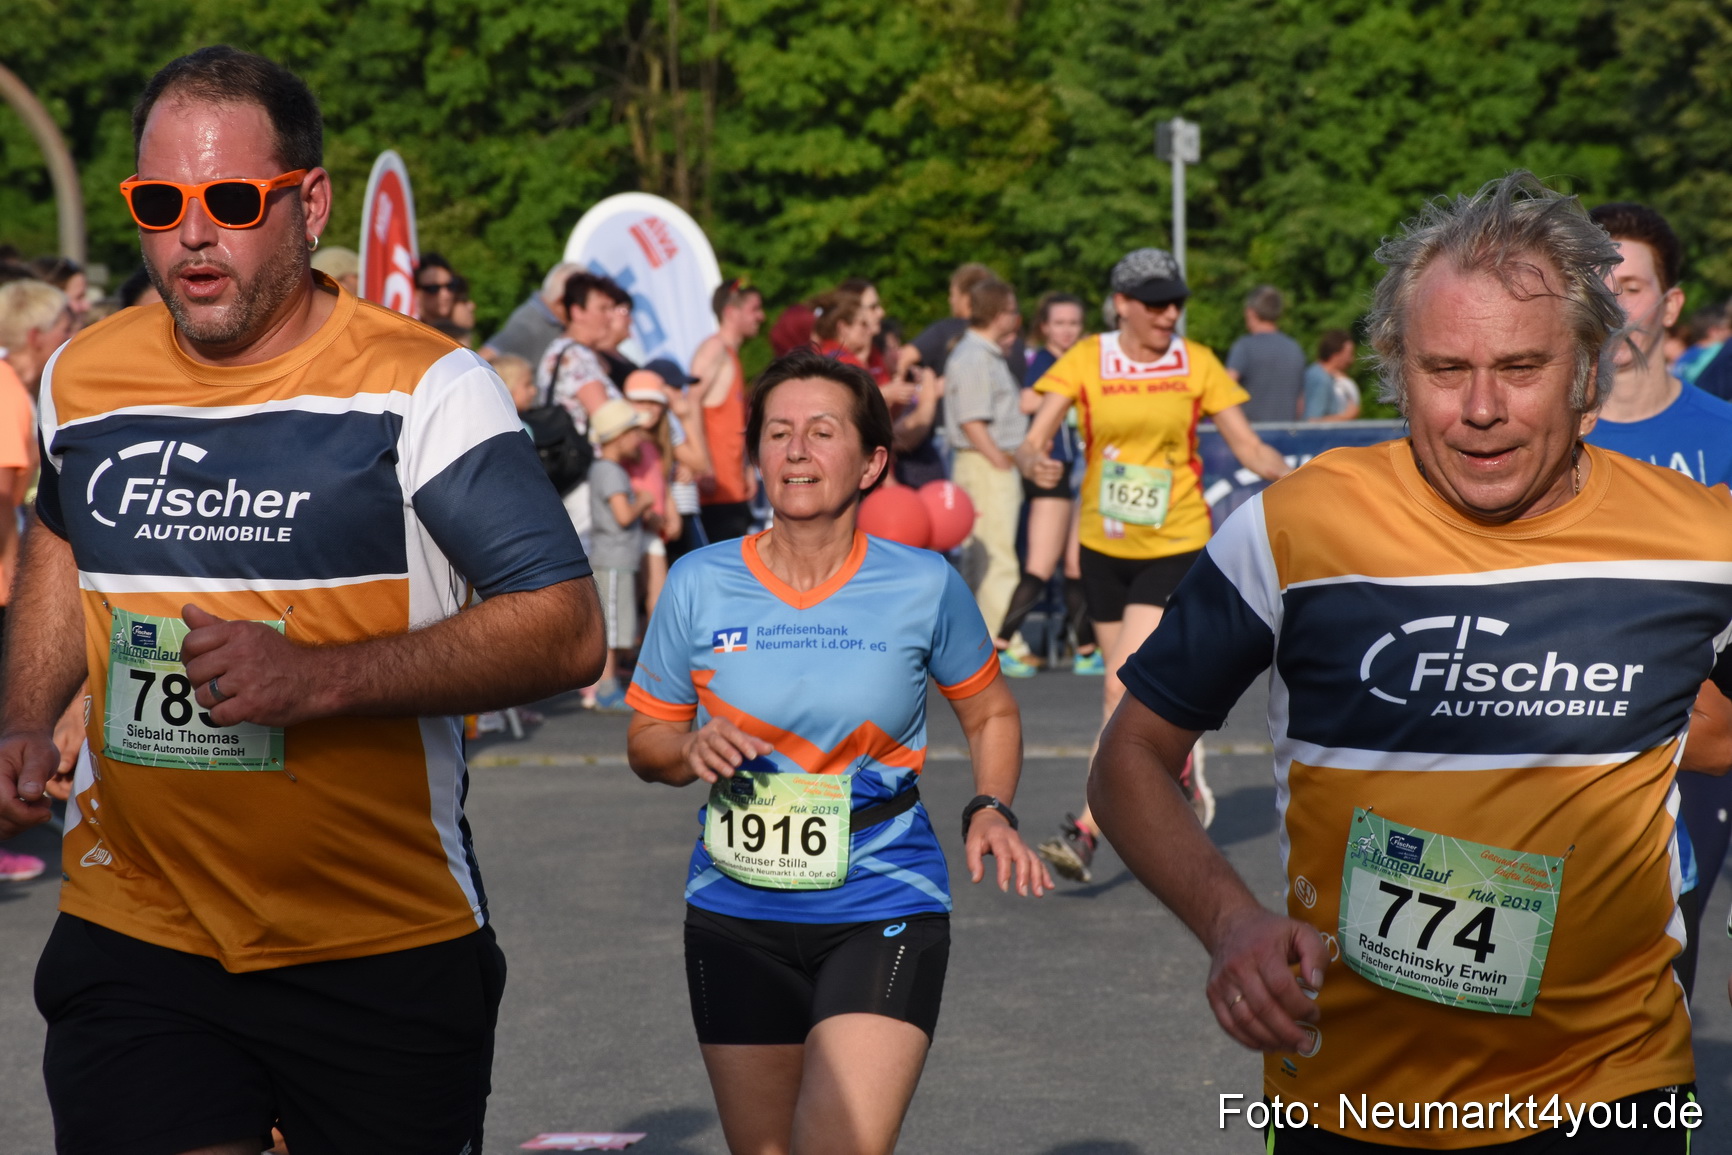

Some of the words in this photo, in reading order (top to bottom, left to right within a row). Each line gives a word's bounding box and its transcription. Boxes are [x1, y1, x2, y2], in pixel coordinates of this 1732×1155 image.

[118, 477, 311, 519] Fischer
[1107, 482, 1159, 509] 1625
[133, 523, 293, 543] AUTOMOBILE
[756, 623, 849, 638] Raiffeisenbank
[755, 637, 818, 651] Neumarkt
[869, 641, 888, 652] eG
[1409, 651, 1645, 693] Fischer
[129, 669, 226, 729] 78
[1430, 699, 1630, 718] AUTOMOBILE
[126, 723, 174, 742] Siebald
[177, 729, 240, 745] Thomas
[122, 738, 151, 752] Fischer
[153, 743, 210, 757] Automobile
[212, 747, 246, 757] GmbH
[811, 805, 840, 815] 2019
[720, 809, 828, 857] 1916
[734, 851, 775, 867] Krauser
[778, 857, 808, 869] Stilla
[1371, 848, 1454, 885] firmenlauf
[1480, 849, 1519, 869] Gesunde
[756, 867, 792, 878] Neumarkt
[825, 871, 837, 879] eG
[1467, 887, 1497, 905] run
[1500, 894, 1543, 913] 2019
[1377, 880, 1497, 964] 774
[1358, 933, 1455, 978] Radschinsky
[1459, 963, 1508, 986] Erwin
[1360, 951, 1394, 973] Fischer
[1394, 965, 1459, 990] Automobile
[1462, 982, 1499, 997] GmbH
